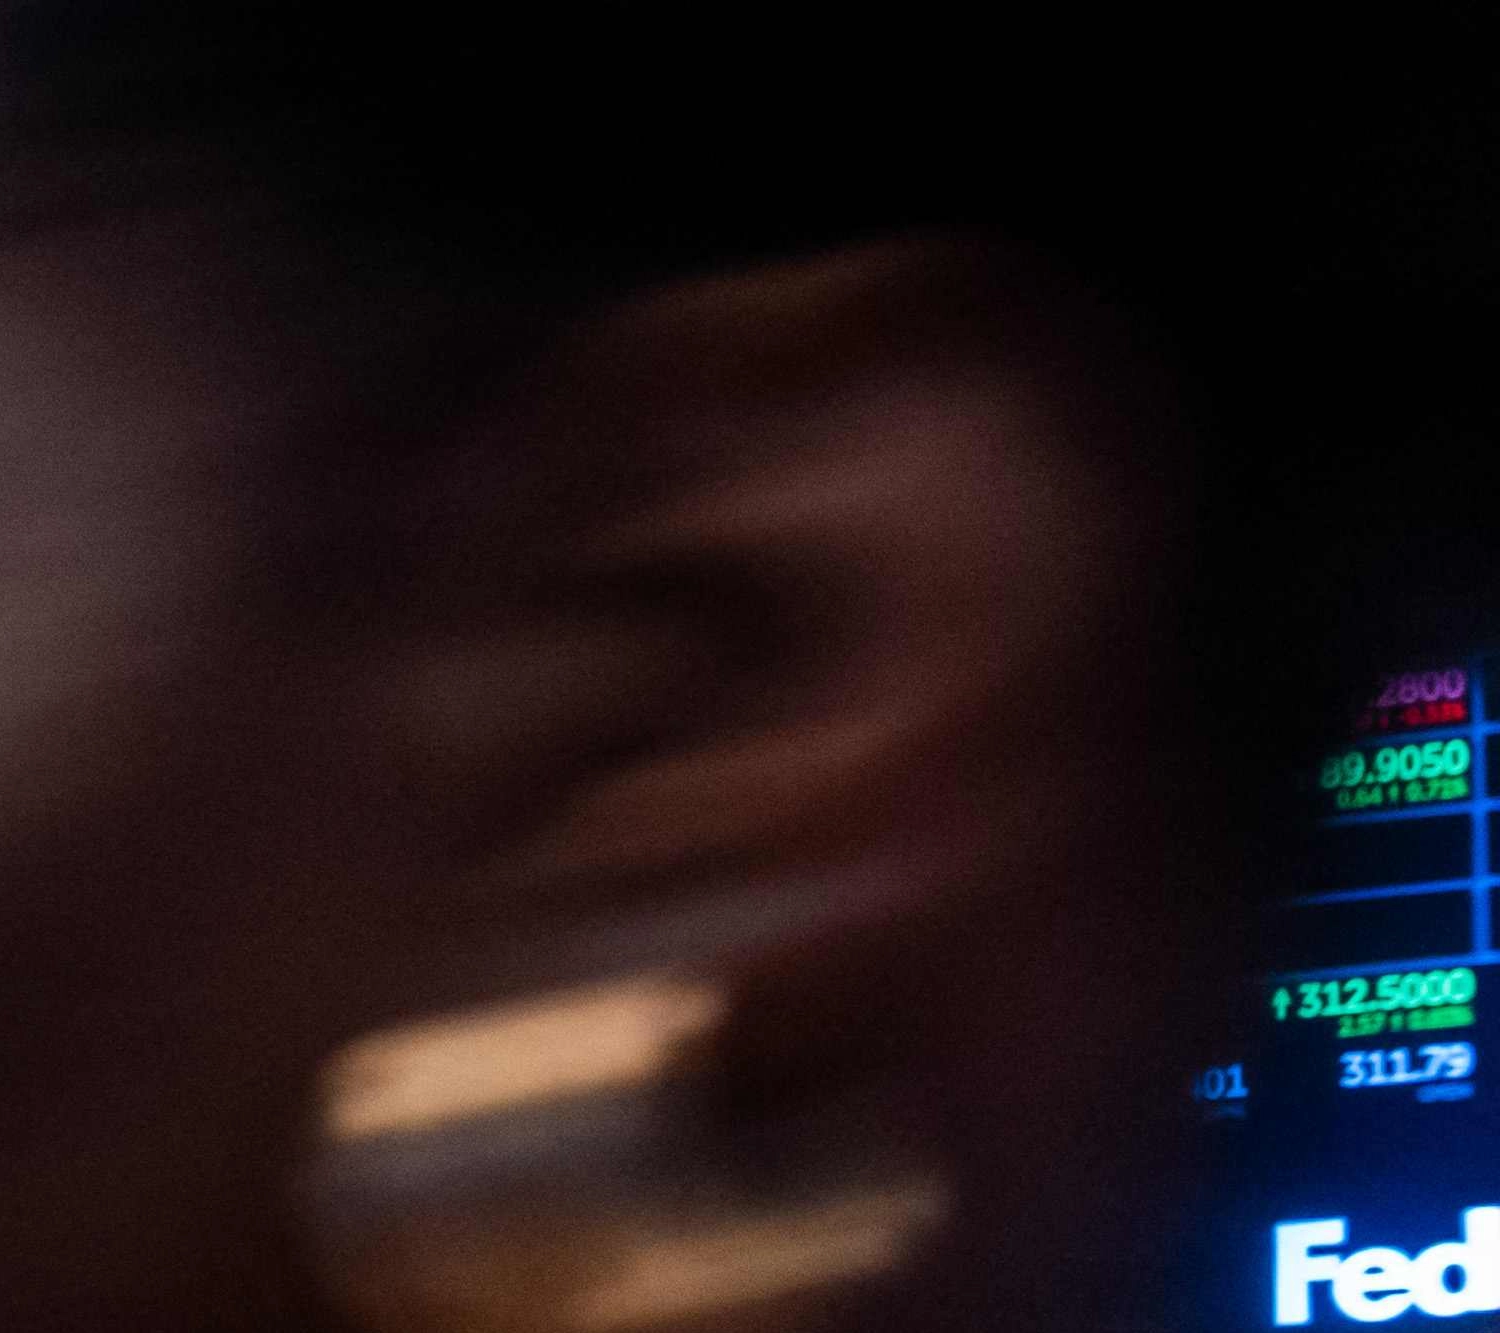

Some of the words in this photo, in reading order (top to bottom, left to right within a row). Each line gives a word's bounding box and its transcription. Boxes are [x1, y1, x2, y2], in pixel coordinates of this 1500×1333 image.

[1297, 967, 1476, 1018] 312.5000
[1339, 1042, 1477, 1089] 311.79
[1271, 1205, 1500, 1328] Fed
